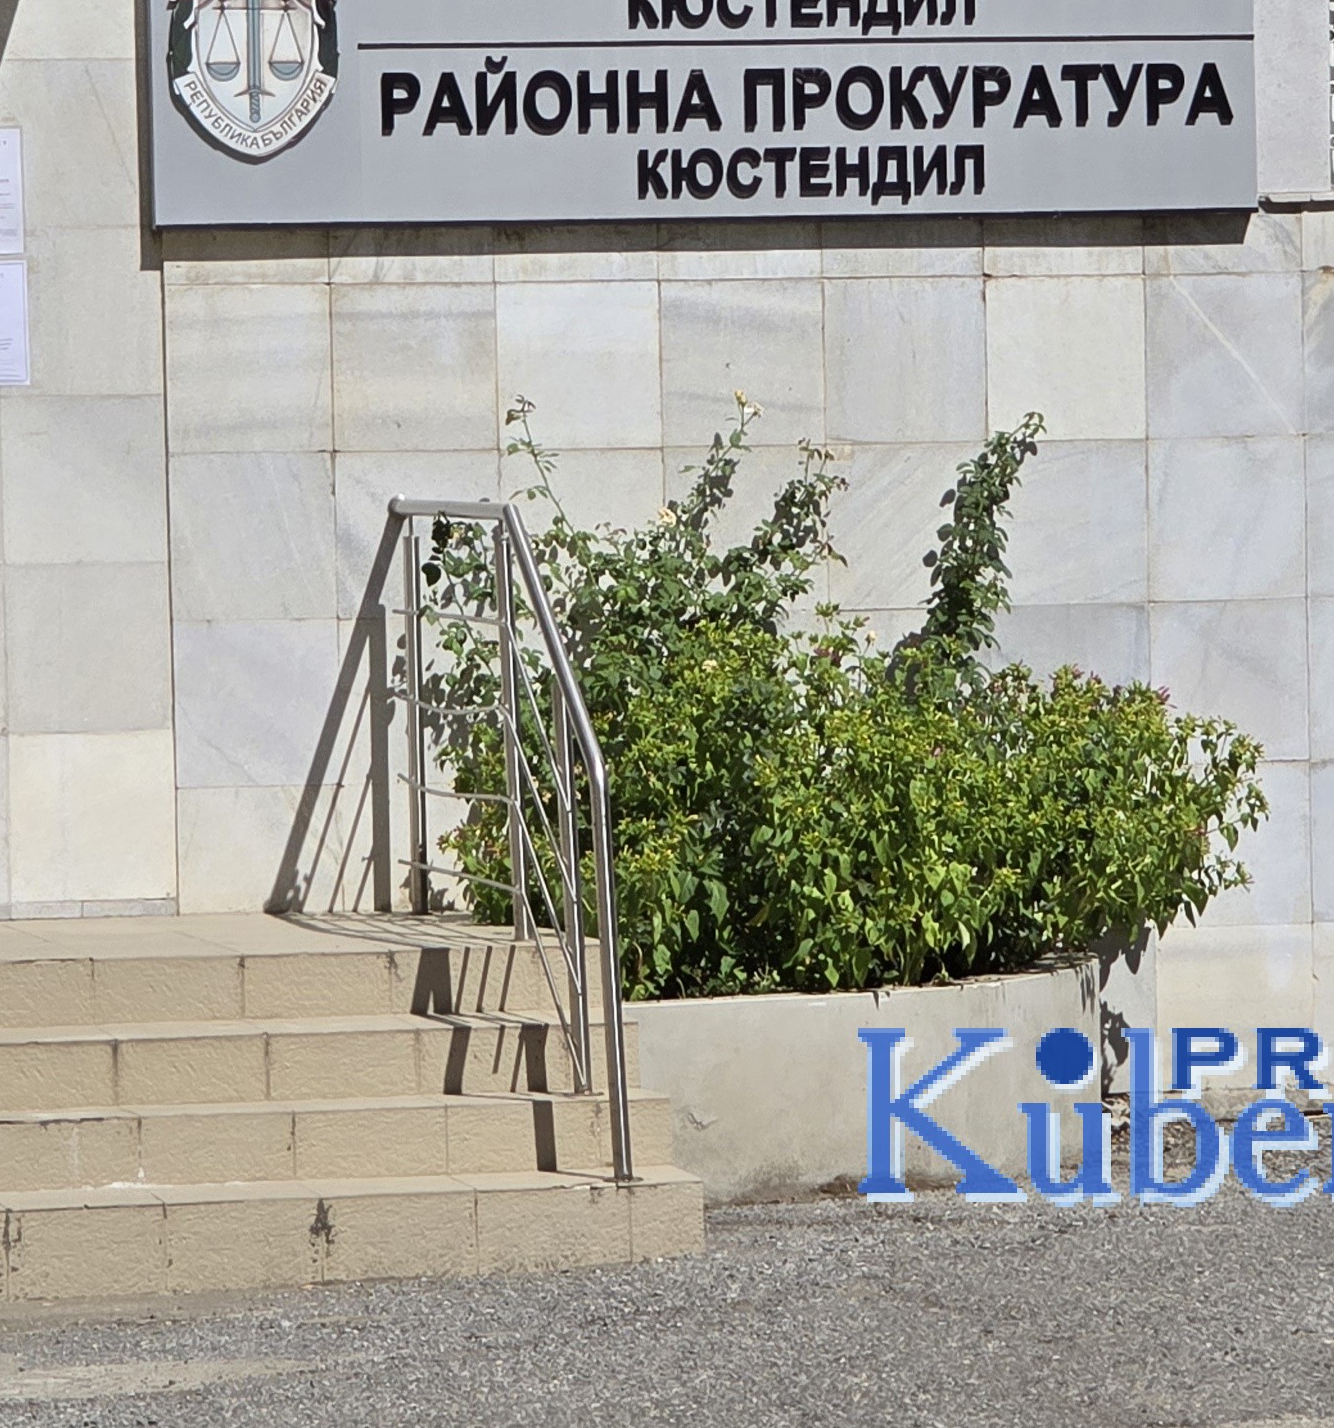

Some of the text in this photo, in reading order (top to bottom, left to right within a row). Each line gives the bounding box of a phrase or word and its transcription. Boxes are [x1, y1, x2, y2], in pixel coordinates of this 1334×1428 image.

[183, 78, 327, 150] РЕПУБЛИКА БЪЛГАРИЯ
[380, 56, 1234, 136] РАЙОННА ПРОКУРАТУРА
[637, 144, 985, 205] КЮСТЕНДИЛ
